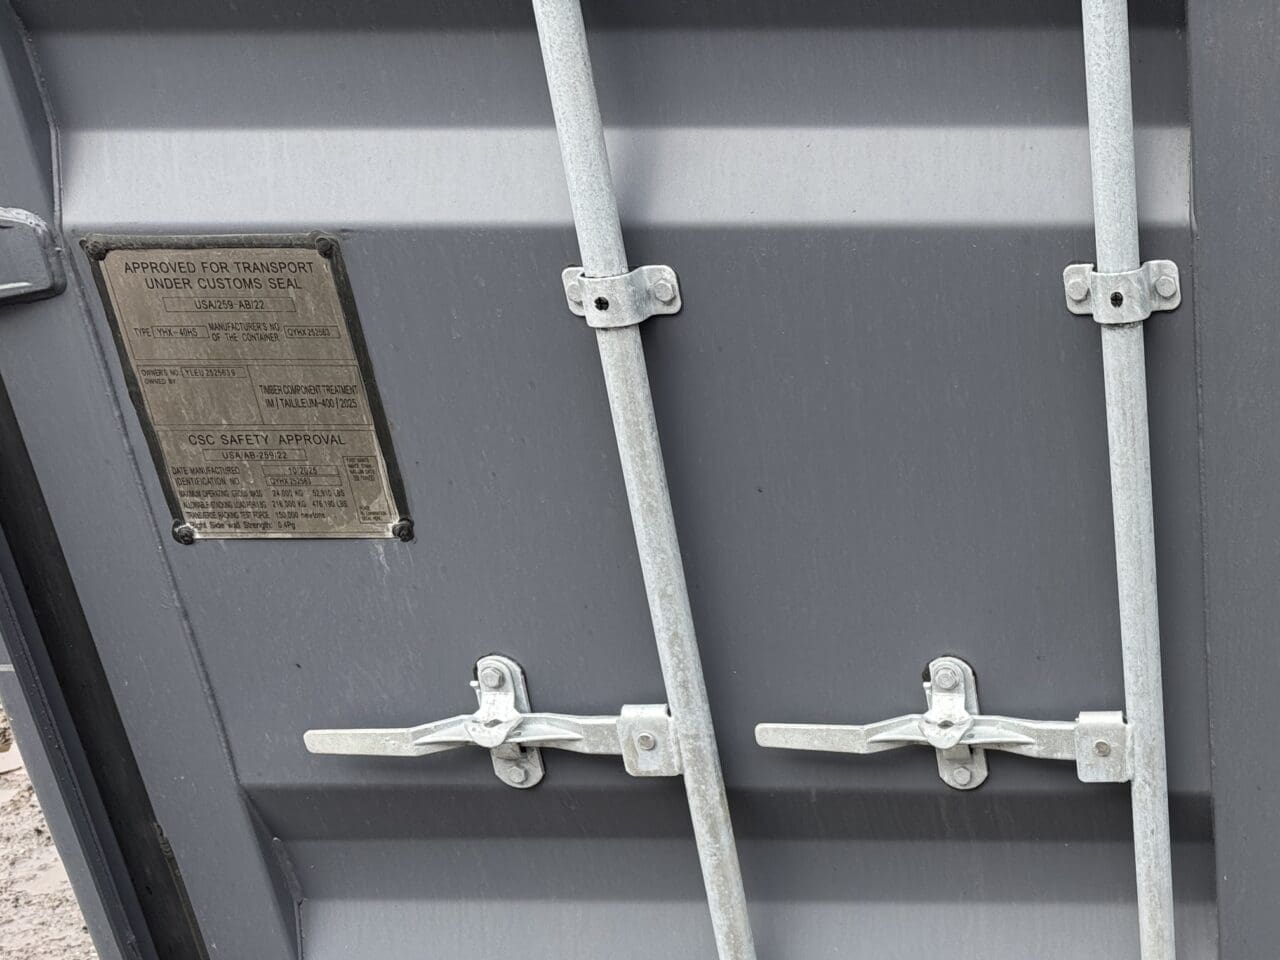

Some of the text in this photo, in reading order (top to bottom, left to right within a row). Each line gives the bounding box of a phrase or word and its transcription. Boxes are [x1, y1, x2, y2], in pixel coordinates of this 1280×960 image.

[124, 261, 314, 274] APPROVED FOR TRANSPORT
[145, 277, 303, 290] UNDER CUSTOMS SEAL
[133, 327, 152, 337] TYPE
[211, 332, 280, 342] OF THE CONTAINER
[188, 434, 346, 445] CSC SAFETY APPROVAL
[171, 466, 189, 475] DATE
[189, 466, 241, 475] MANUFACTURED
